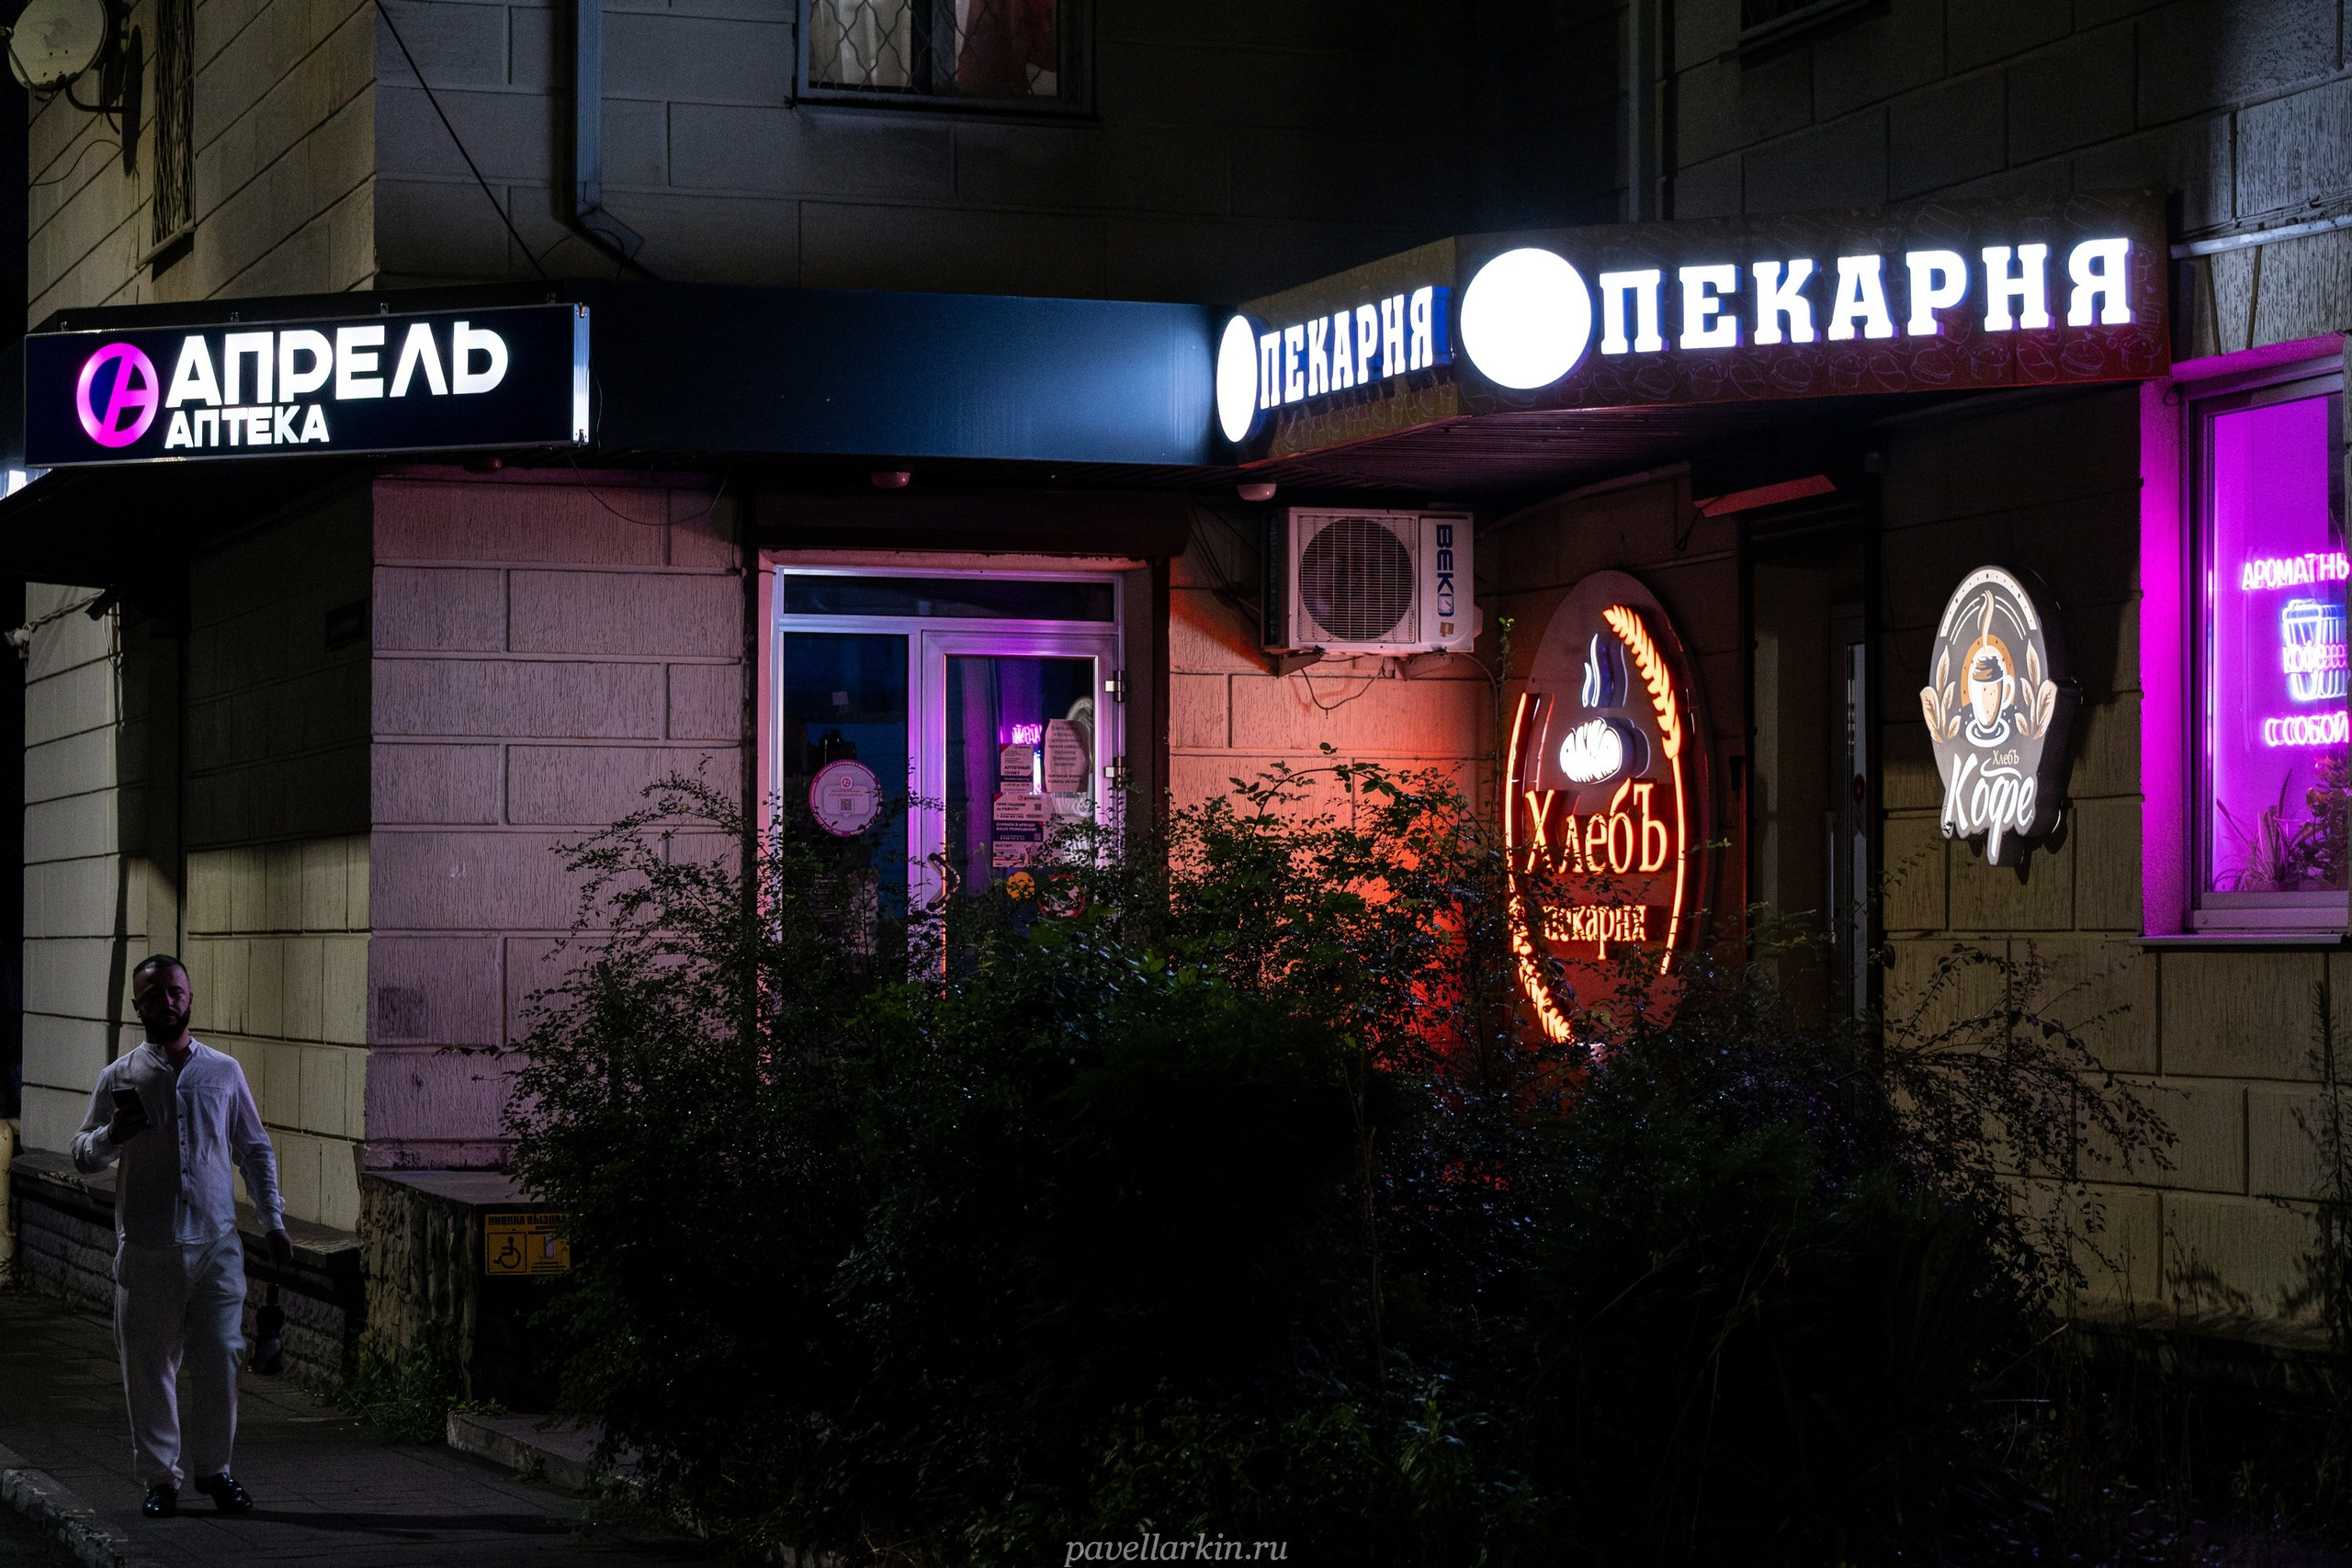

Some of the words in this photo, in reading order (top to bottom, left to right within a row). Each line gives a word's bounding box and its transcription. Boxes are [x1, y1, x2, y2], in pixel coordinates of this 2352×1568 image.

[1600, 237, 2132, 355] ПЕКАРНЯ
[165, 321, 509, 410] АПРЕЛЬ
[1259, 285, 1434, 411] ПЕКАРНЯ
[164, 404, 331, 450] АПТЕКА
[1435, 524, 1454, 617] BEKO
[1992, 749, 2019, 766] ХлебЪ
[1943, 752, 2035, 858] Кофе
